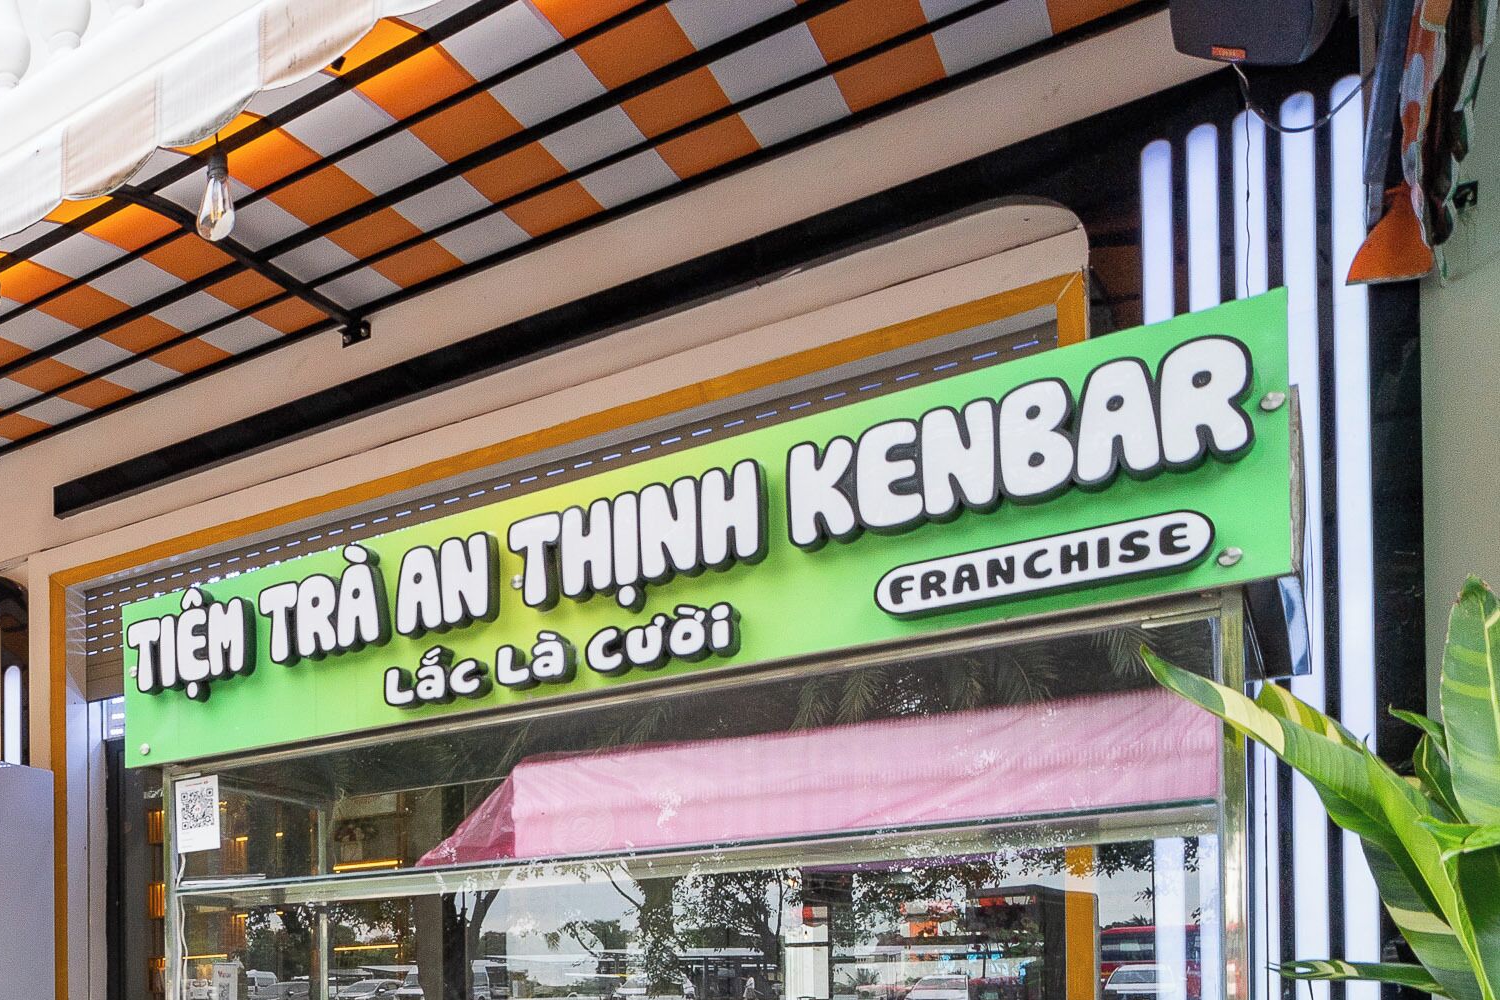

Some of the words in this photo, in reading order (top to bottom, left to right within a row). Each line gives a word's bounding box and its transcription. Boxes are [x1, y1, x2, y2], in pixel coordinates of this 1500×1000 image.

[128, 588, 250, 700] TIỆM
[260, 545, 383, 664] TRÀ
[396, 533, 492, 636] AN
[509, 459, 761, 608] THỊNH
[787, 335, 1252, 547] KENBAR
[889, 522, 1191, 605] FRANCHISE
[385, 646, 482, 706] Lắc
[497, 631, 570, 687] Là
[586, 603, 734, 673] Cười
